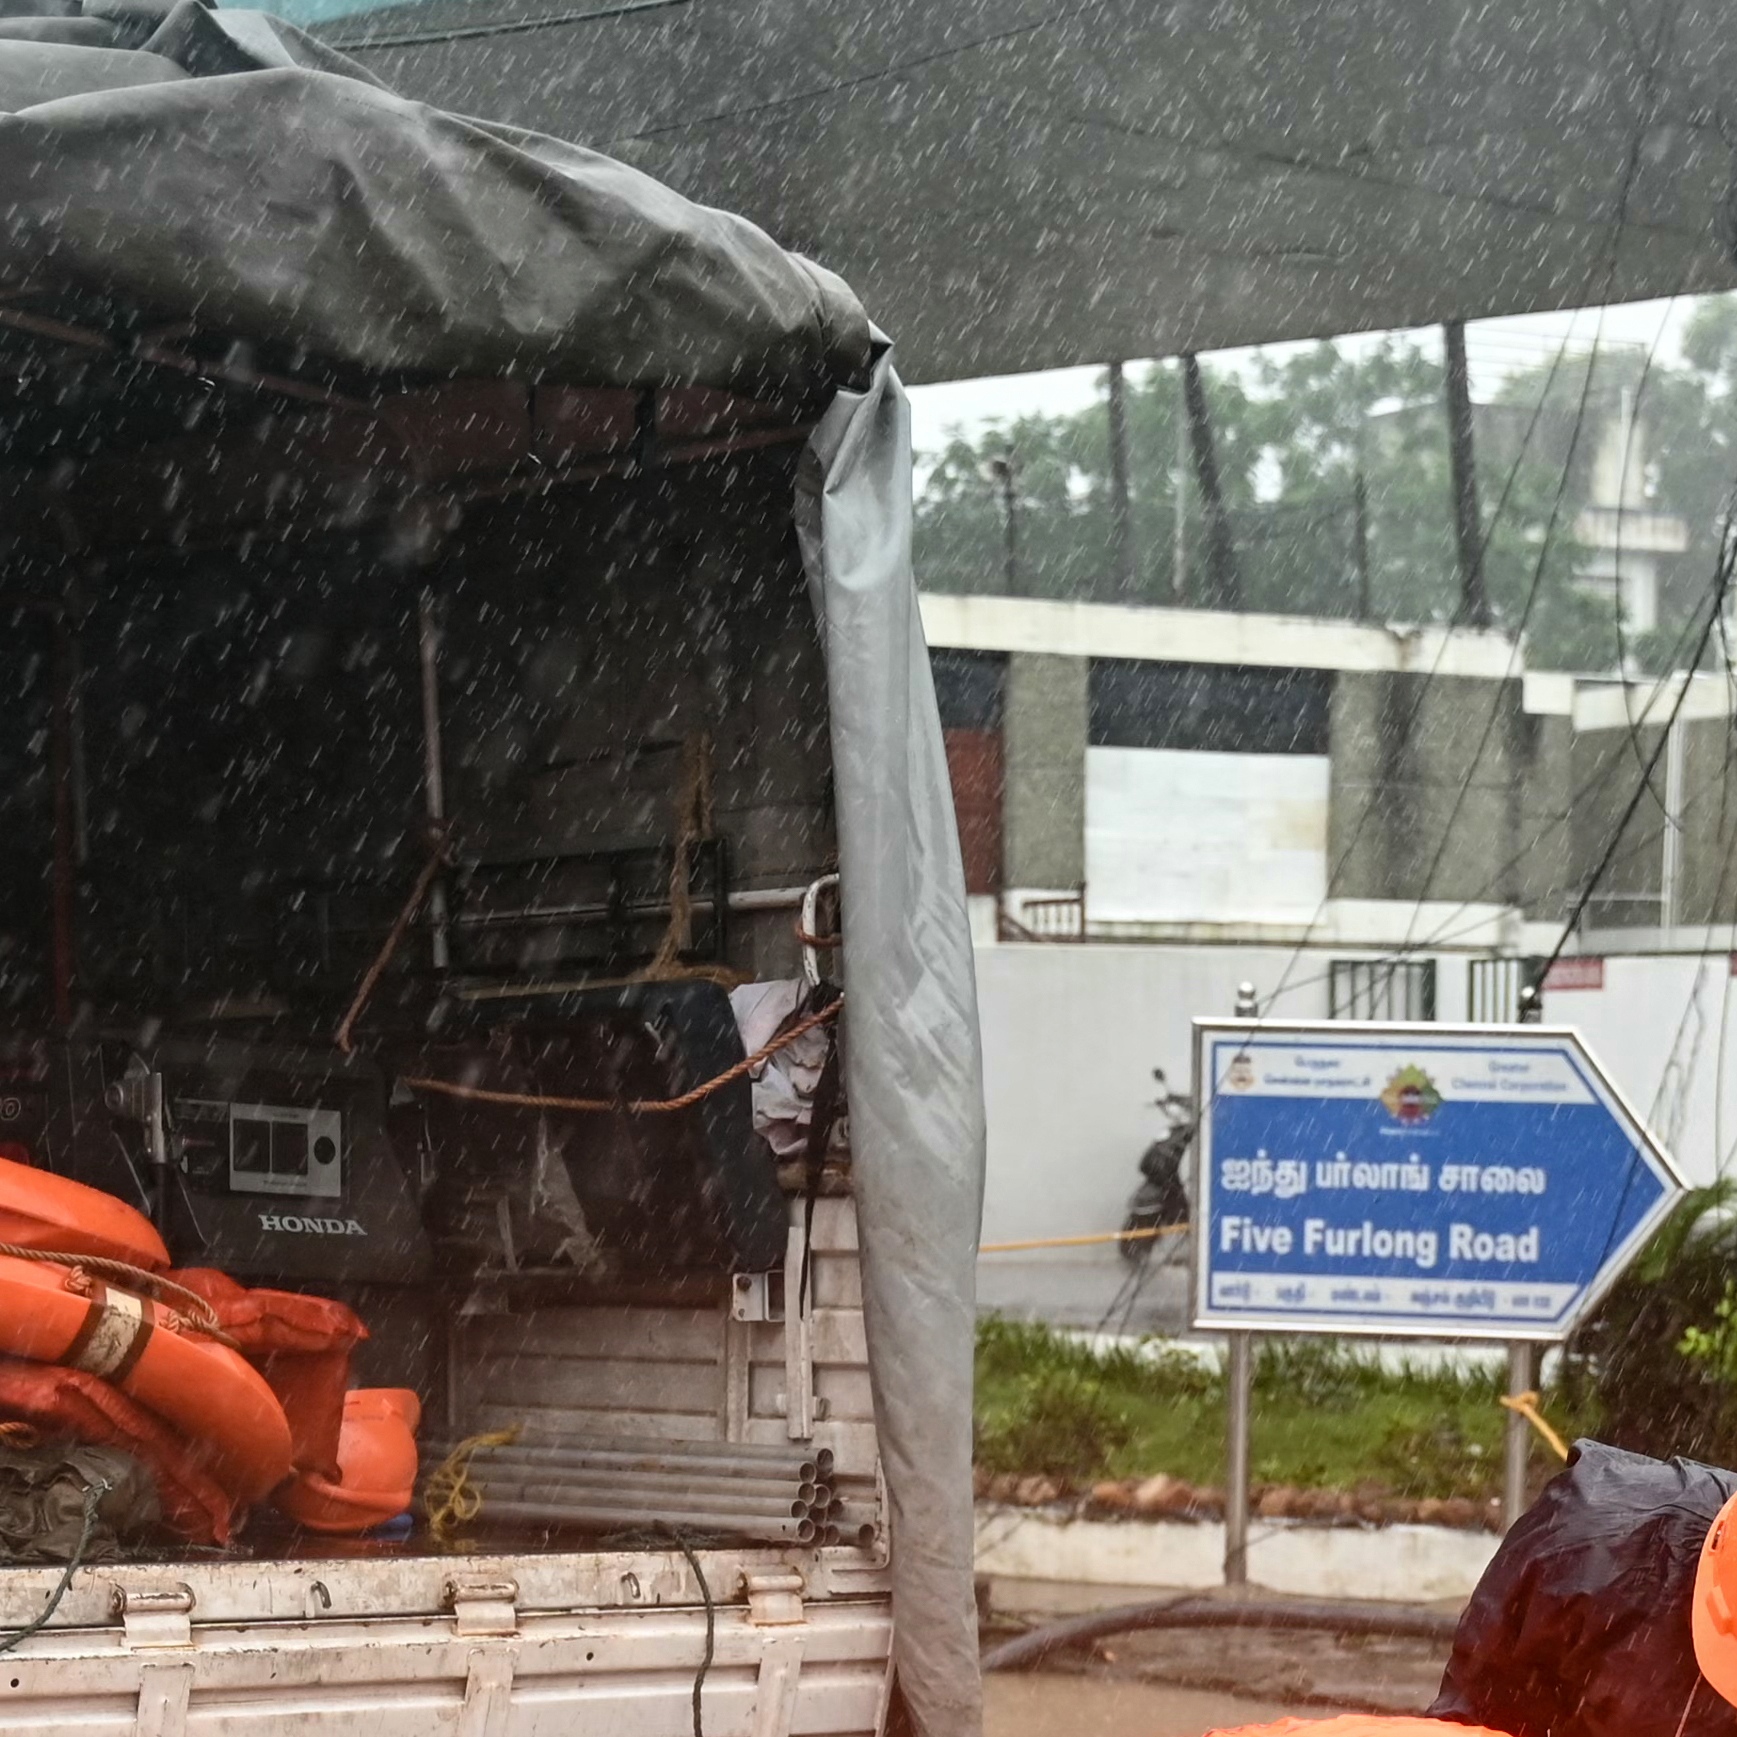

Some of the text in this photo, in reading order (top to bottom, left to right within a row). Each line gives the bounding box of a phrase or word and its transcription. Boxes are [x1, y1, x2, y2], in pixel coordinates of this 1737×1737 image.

[1220, 1148, 1308, 1199] ஐந்து
[1437, 1163, 1547, 1195] சாலை
[258, 1214, 368, 1236] HONDA
[1220, 1215, 1540, 1269] Five Furlong Road
